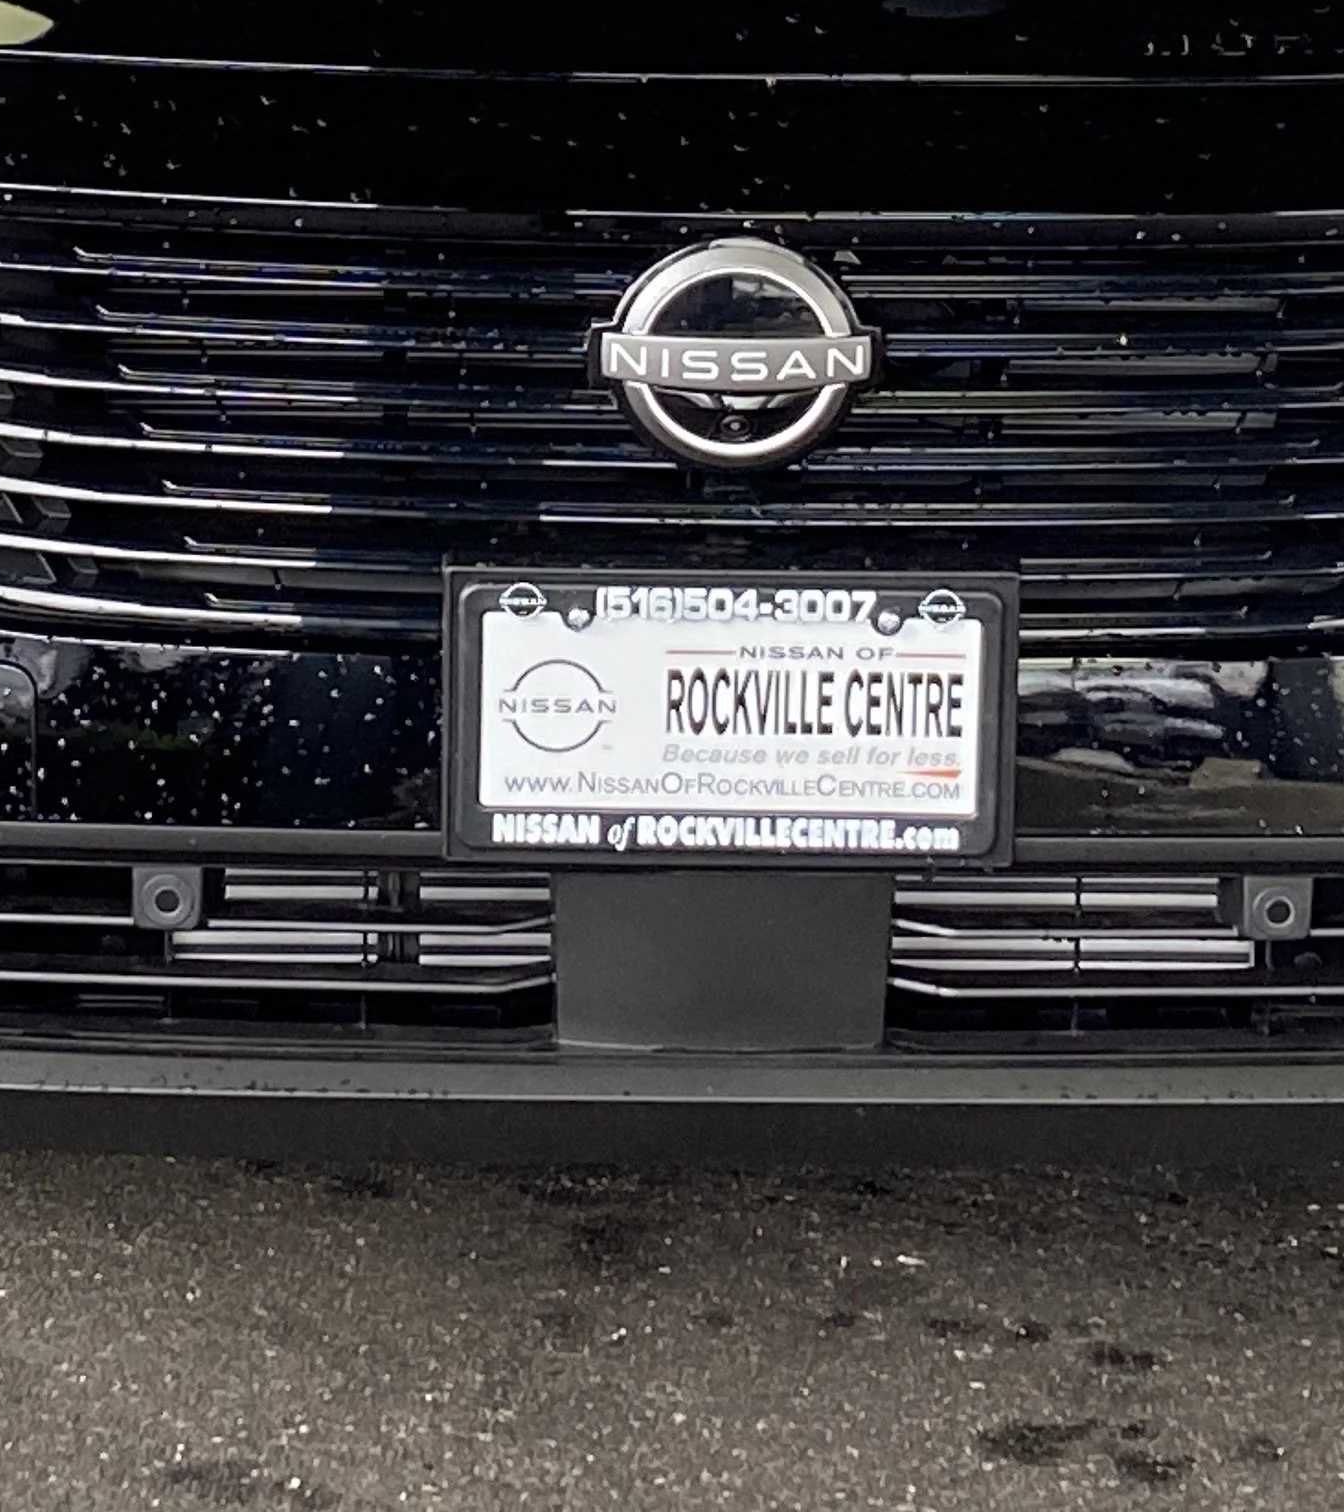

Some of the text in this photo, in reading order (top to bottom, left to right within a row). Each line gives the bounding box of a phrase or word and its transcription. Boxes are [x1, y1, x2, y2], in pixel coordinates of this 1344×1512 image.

[609, 342, 865, 381] NISSAN
[595, 586, 878, 624] (516)504-3007
[739, 645, 896, 661] NISSAN OF
[498, 698, 617, 714] NISSAN
[665, 667, 965, 738] ROCKVILLE CENTRE
[662, 743, 769, 765] Because
[775, 751, 810, 767] we
[816, 745, 860, 767] sell
[865, 745, 902, 767] for
[492, 813, 961, 851] NISSAN of ROCKVILLECENTRE.com
